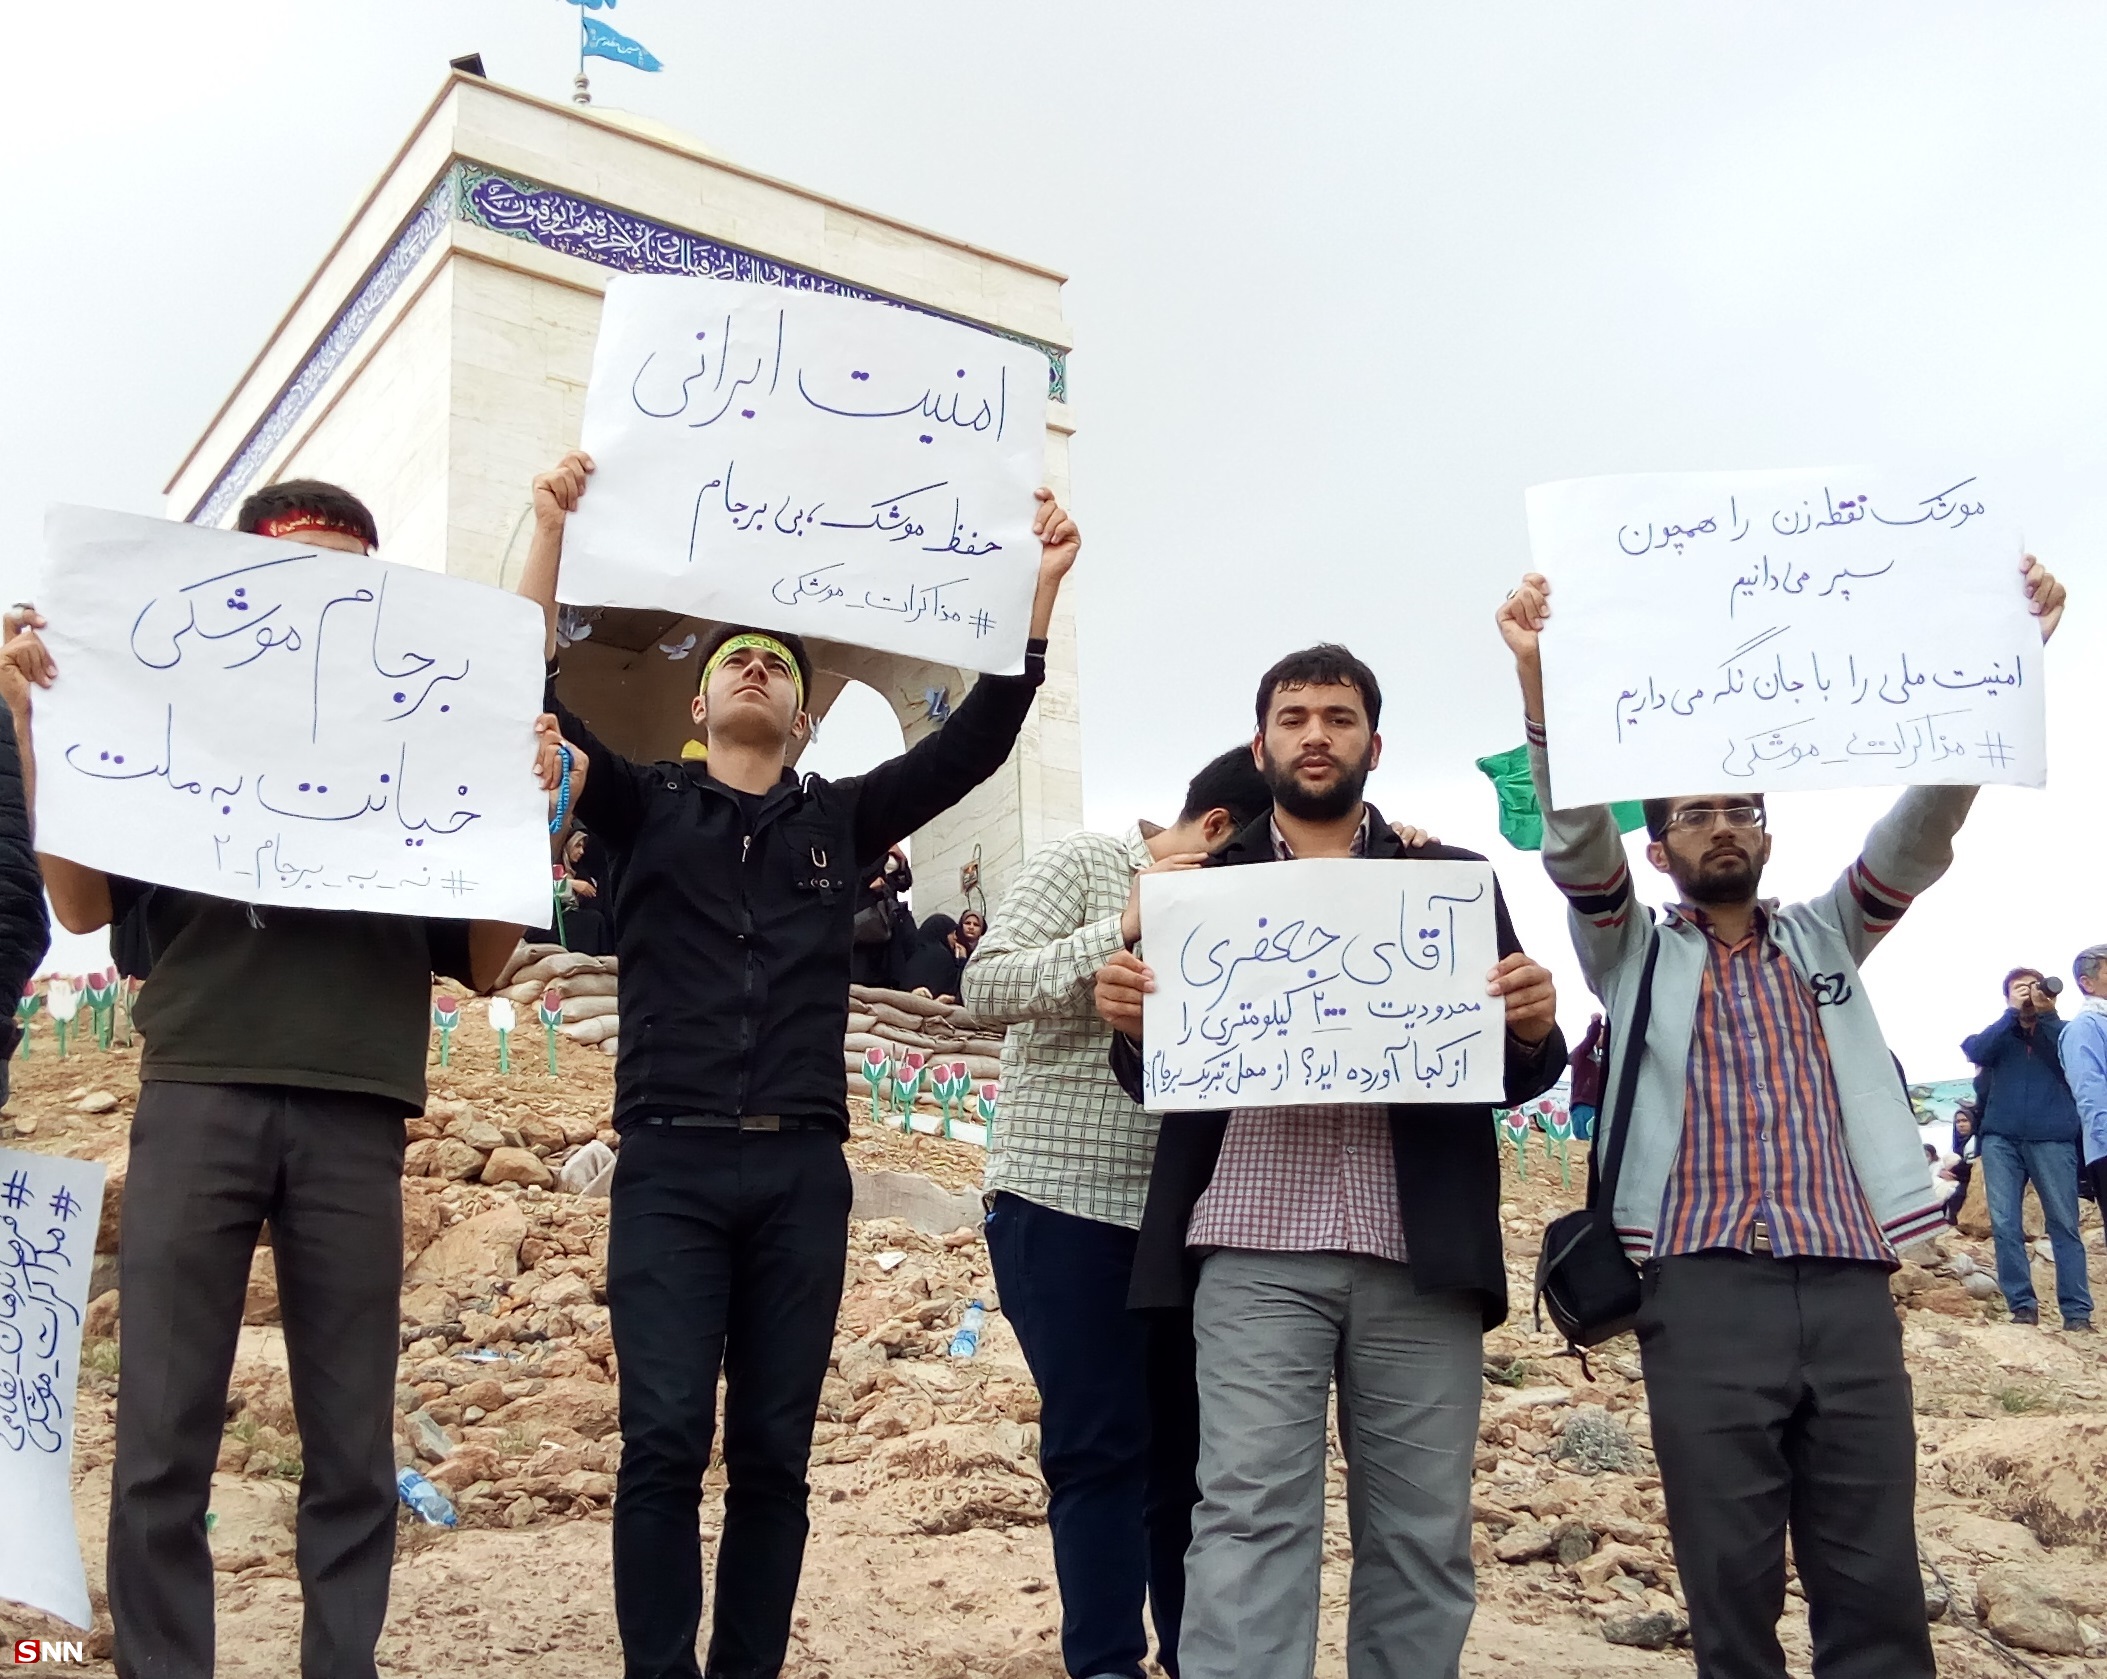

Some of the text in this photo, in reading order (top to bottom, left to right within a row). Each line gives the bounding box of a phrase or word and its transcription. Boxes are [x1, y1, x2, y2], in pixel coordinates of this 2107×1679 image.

[632, 309, 1006, 444] امنیت ایرانی
[689, 460, 767, 562] برجام
[775, 496, 803, 536] بی
[922, 497, 1002, 555] حفظ
[1731, 496, 1750, 541] را
[1871, 477, 1985, 529] موشک
[1618, 515, 1716, 556] همچون
[1820, 560, 1894, 602] سپر
[131, 554, 470, 744] برجام موشکی
[1713, 626, 1791, 704] نگه
[1753, 654, 1804, 704] جان
[1812, 652, 1831, 703] با
[1850, 655, 1868, 704] را
[1878, 653, 1924, 704] ملی
[1933, 655, 2022, 695] امنیت
[65, 703, 481, 848] خیانت به ملت
[1180, 883, 1484, 1012] آقای جعفری
[1176, 1001, 1192, 1046] را
[1201, 973, 1340, 1046] کیلومتری
[1368, 1000, 1481, 1029] محدودیت
[1178, 1043, 1240, 1099] تبریک
[1226, 1052, 1267, 1094] محل
[1271, 1049, 1289, 1090] از
[1346, 1036, 1410, 1092] آورده
[1413, 1030, 1482, 1088] کجا
[1446, 1048, 1467, 1088] از
